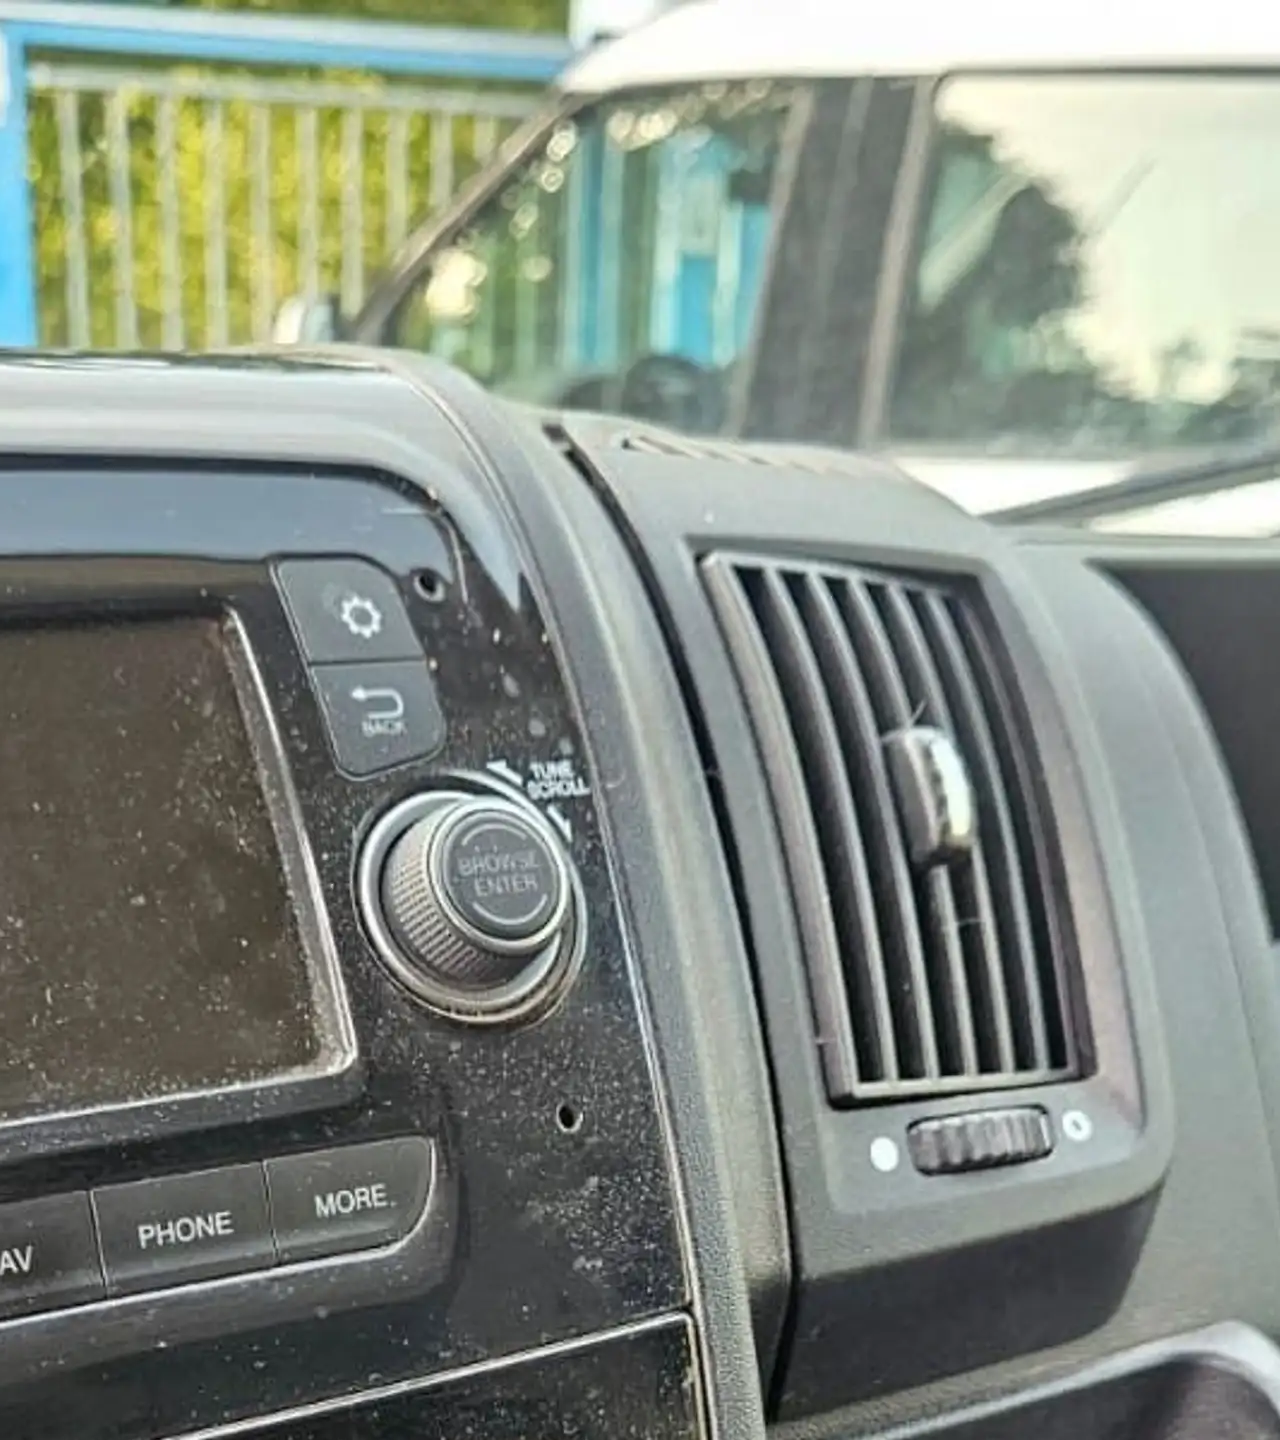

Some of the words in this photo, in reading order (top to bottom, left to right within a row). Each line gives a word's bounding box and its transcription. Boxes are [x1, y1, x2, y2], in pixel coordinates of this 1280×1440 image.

[527, 775, 590, 800] SCROLL
[313, 1184, 388, 1218] MORE
[137, 1210, 234, 1249] PHONE
